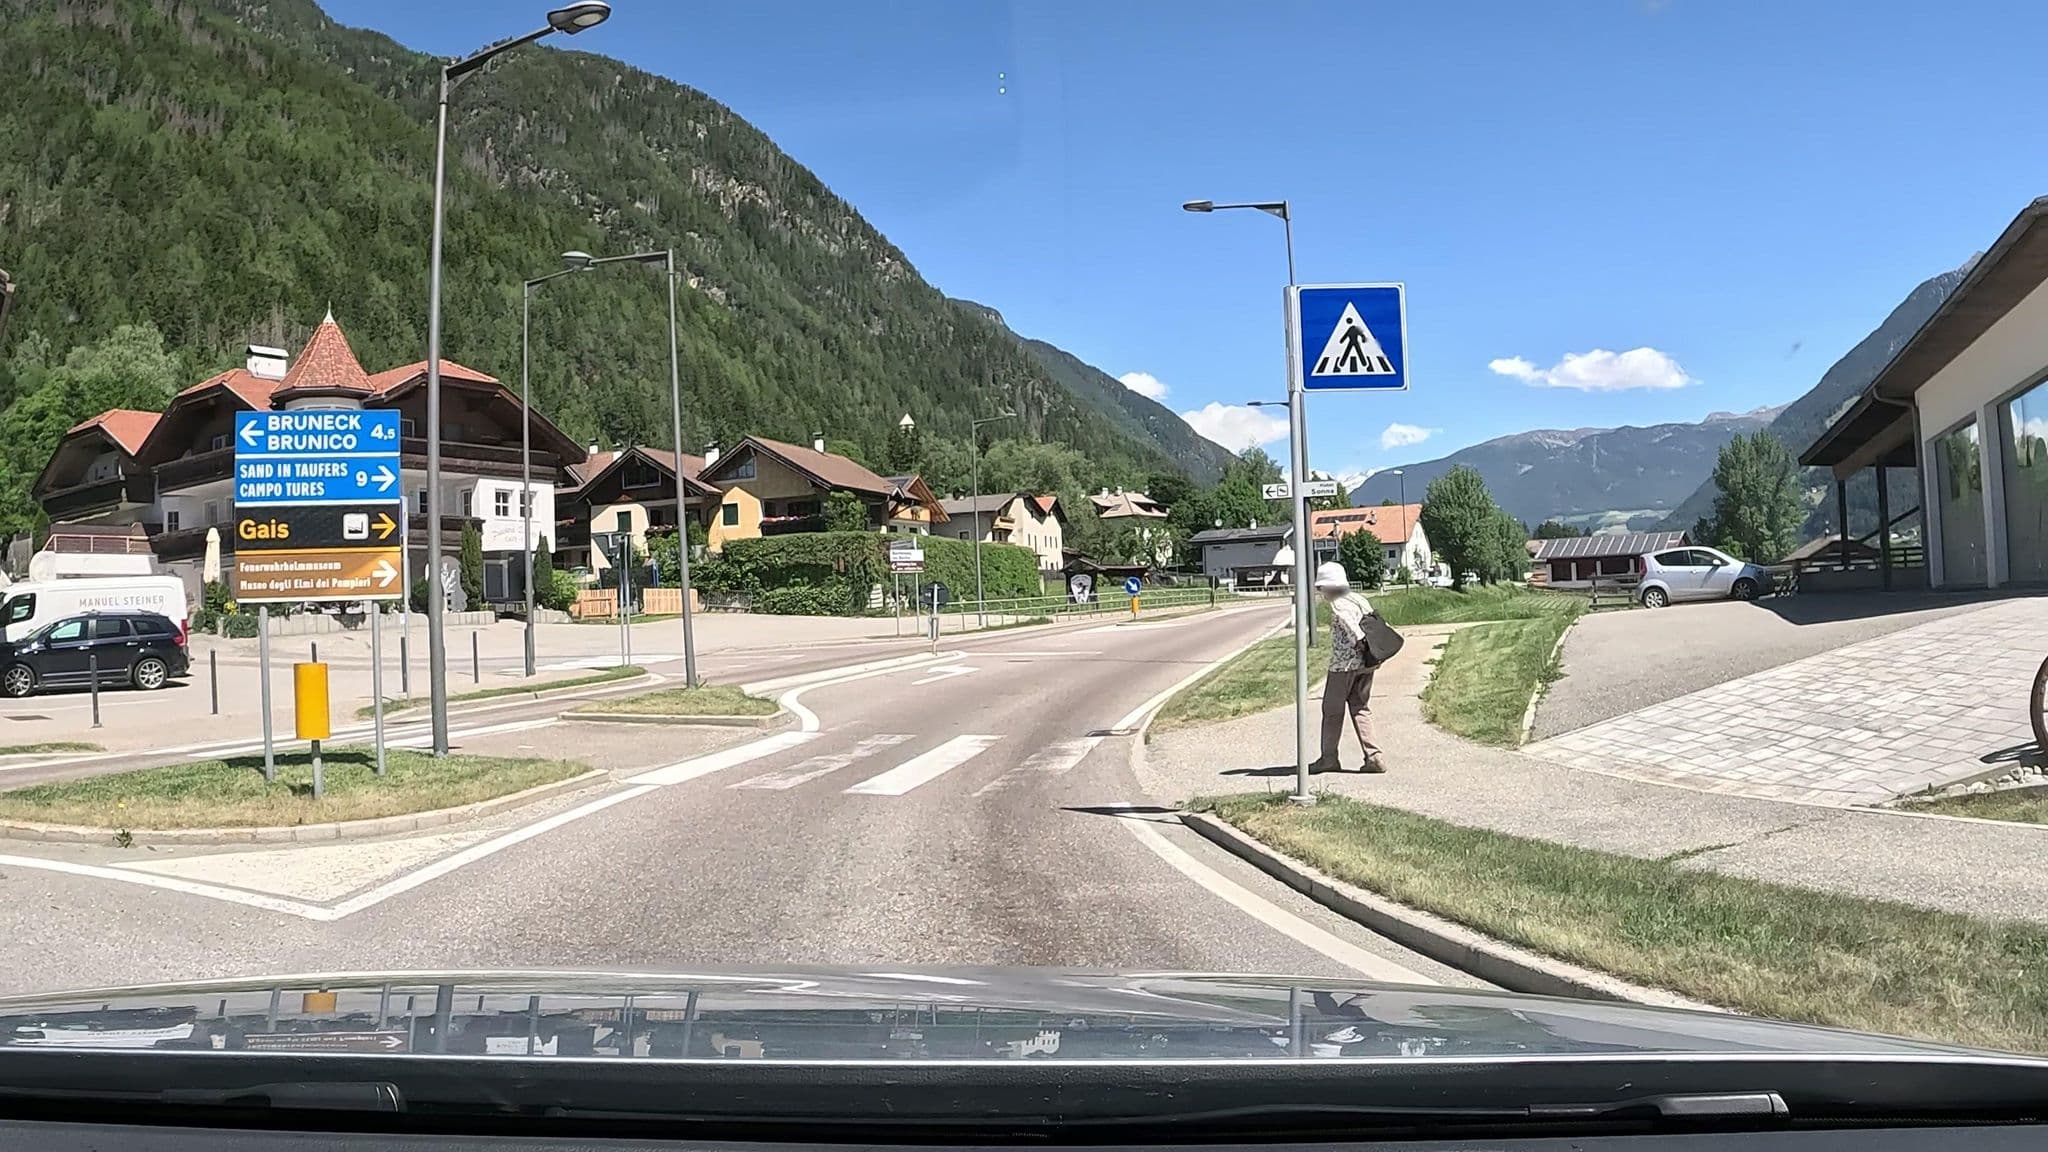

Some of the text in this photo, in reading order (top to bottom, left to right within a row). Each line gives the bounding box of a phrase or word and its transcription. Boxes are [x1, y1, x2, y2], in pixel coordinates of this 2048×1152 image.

[267, 414, 362, 431] BRUNECK
[370, 423, 396, 441] 4,5
[267, 434, 358, 451] BRUNICO
[239, 462, 348, 479] SAND IN TAUFERS
[355, 470, 368, 487] 9
[239, 482, 325, 498] CAMPO TURES
[239, 518, 289, 540] Gais
[240, 580, 267, 590] Museo
[269, 579, 291, 591] degli
[293, 578, 314, 589] Elmi
[315, 578, 330, 588] dei
[79, 595, 164, 607] MANUEL STEINER
